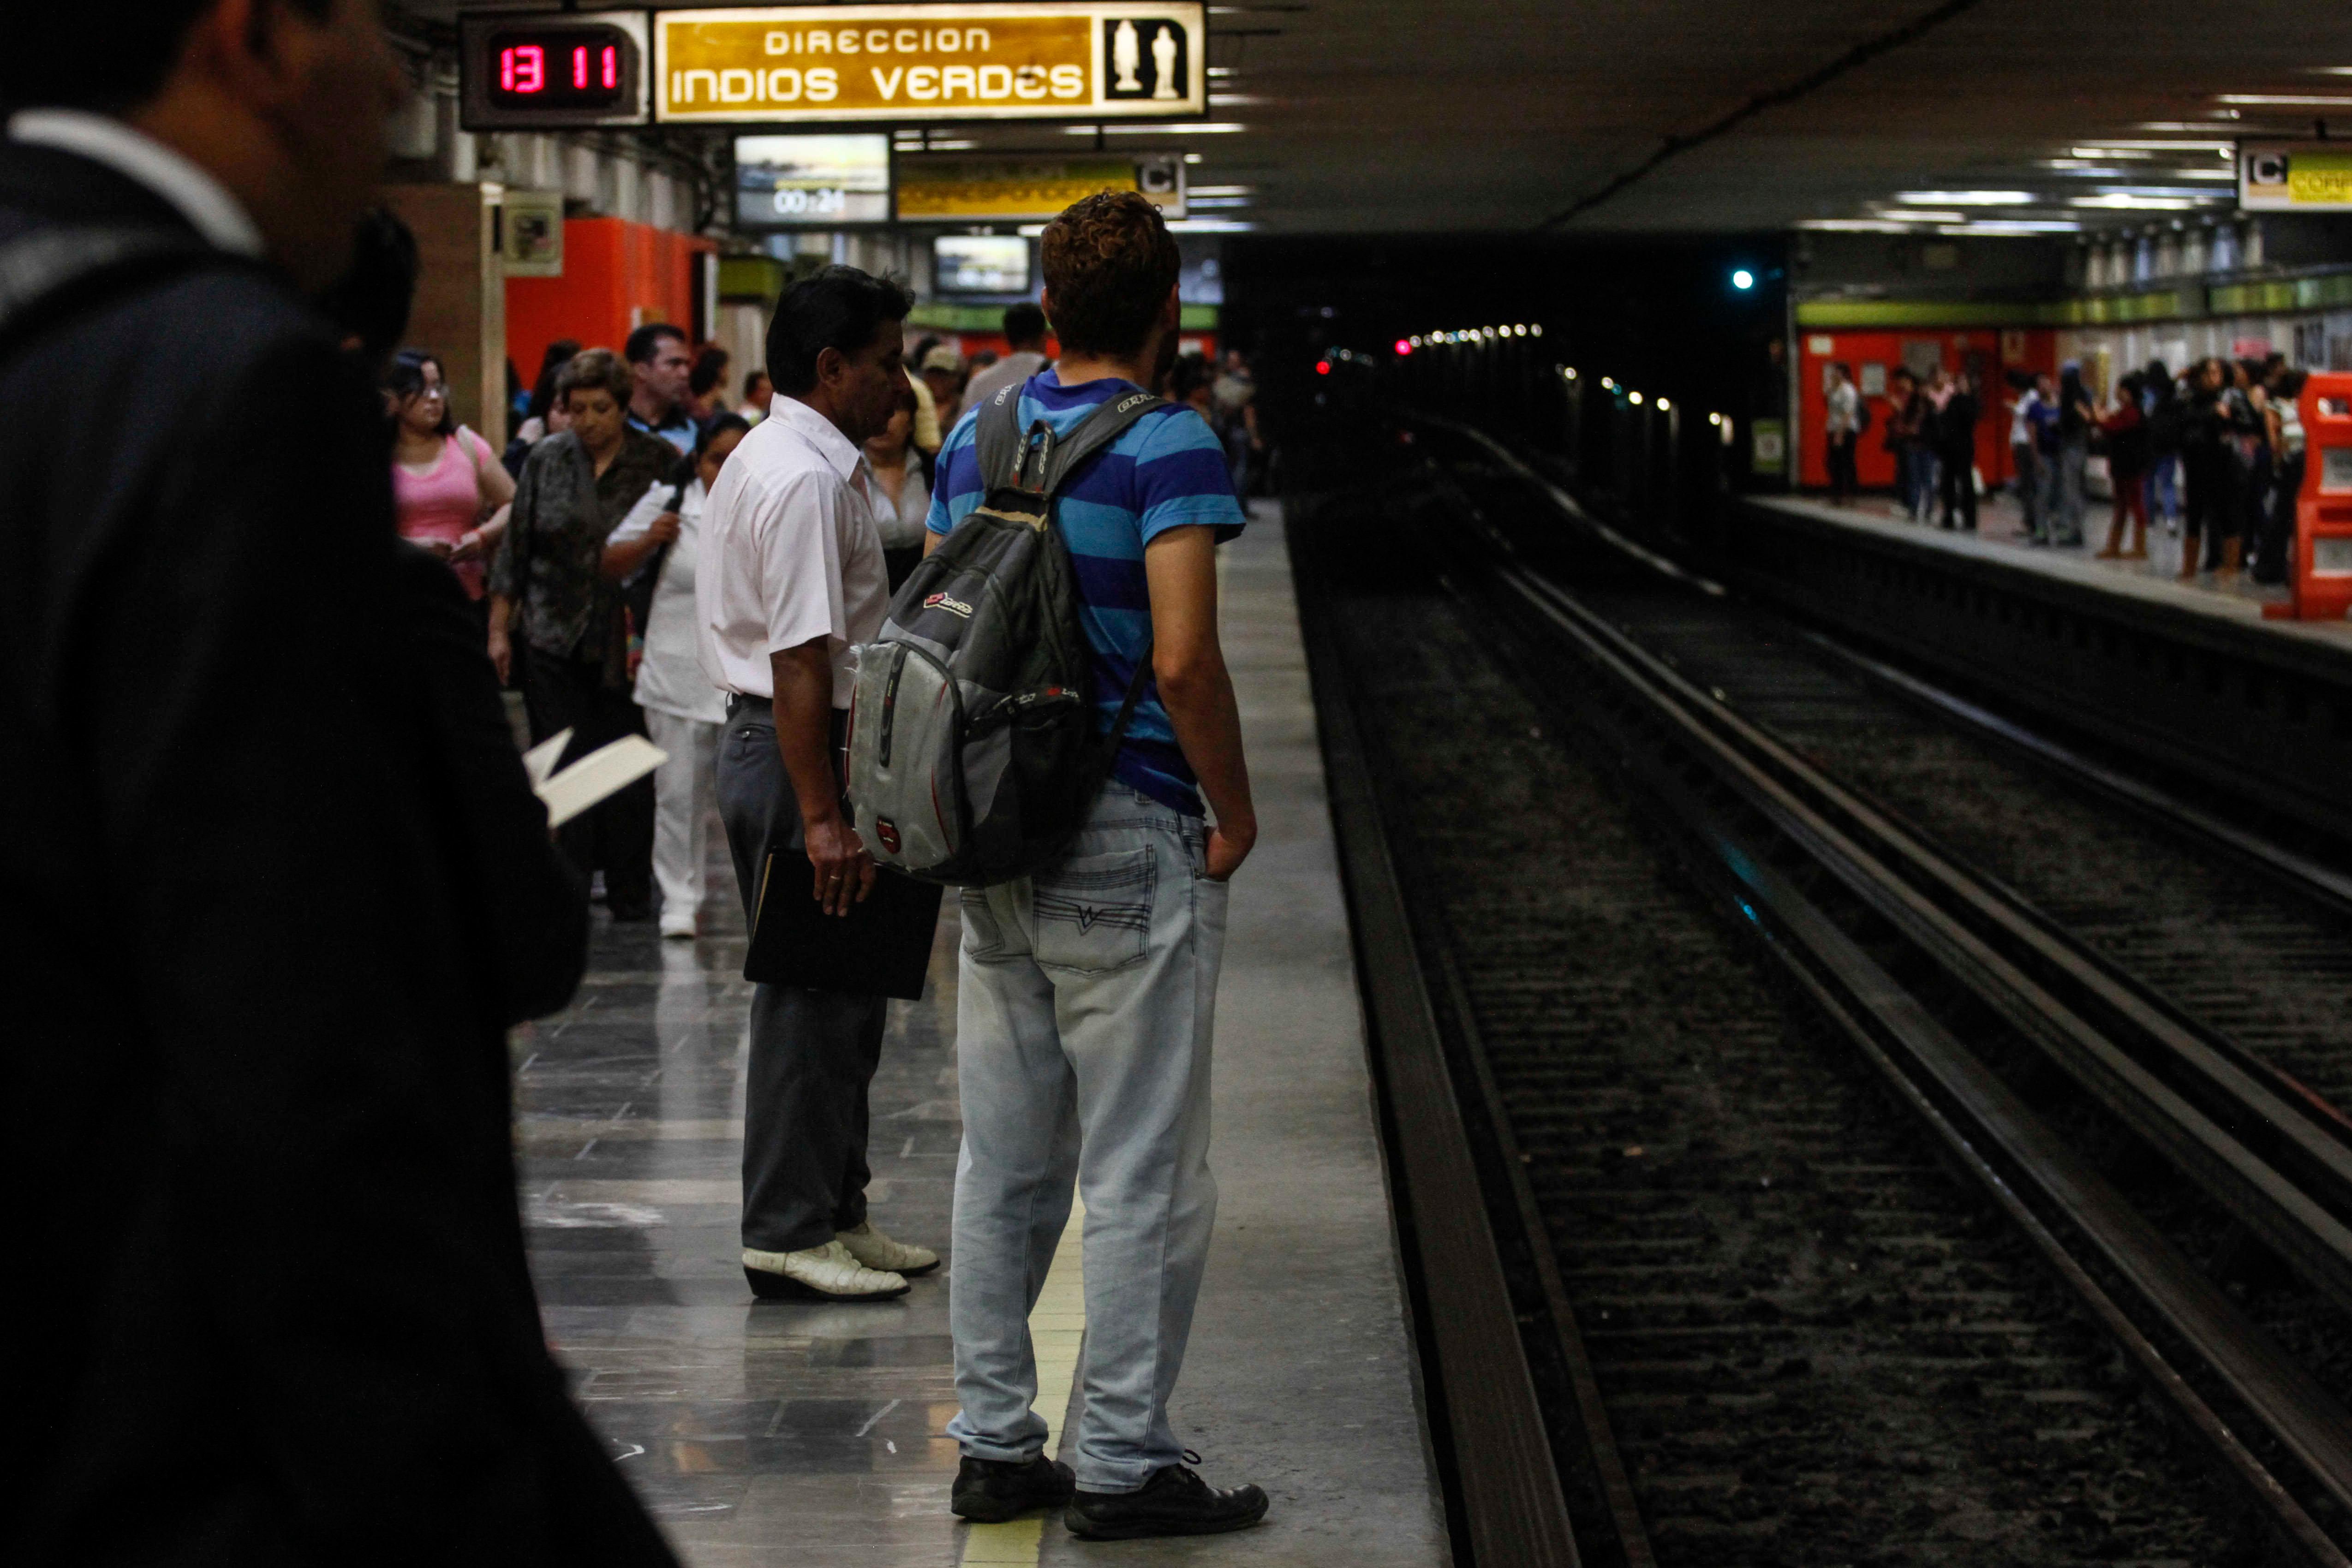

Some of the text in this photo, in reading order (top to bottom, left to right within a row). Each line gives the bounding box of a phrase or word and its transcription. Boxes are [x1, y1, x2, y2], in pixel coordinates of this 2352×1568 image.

[764, 28, 991, 55] DIRECCION
[501, 46, 616, 93] 13 11
[672, 64, 1084, 103] INDIOS VERDES
